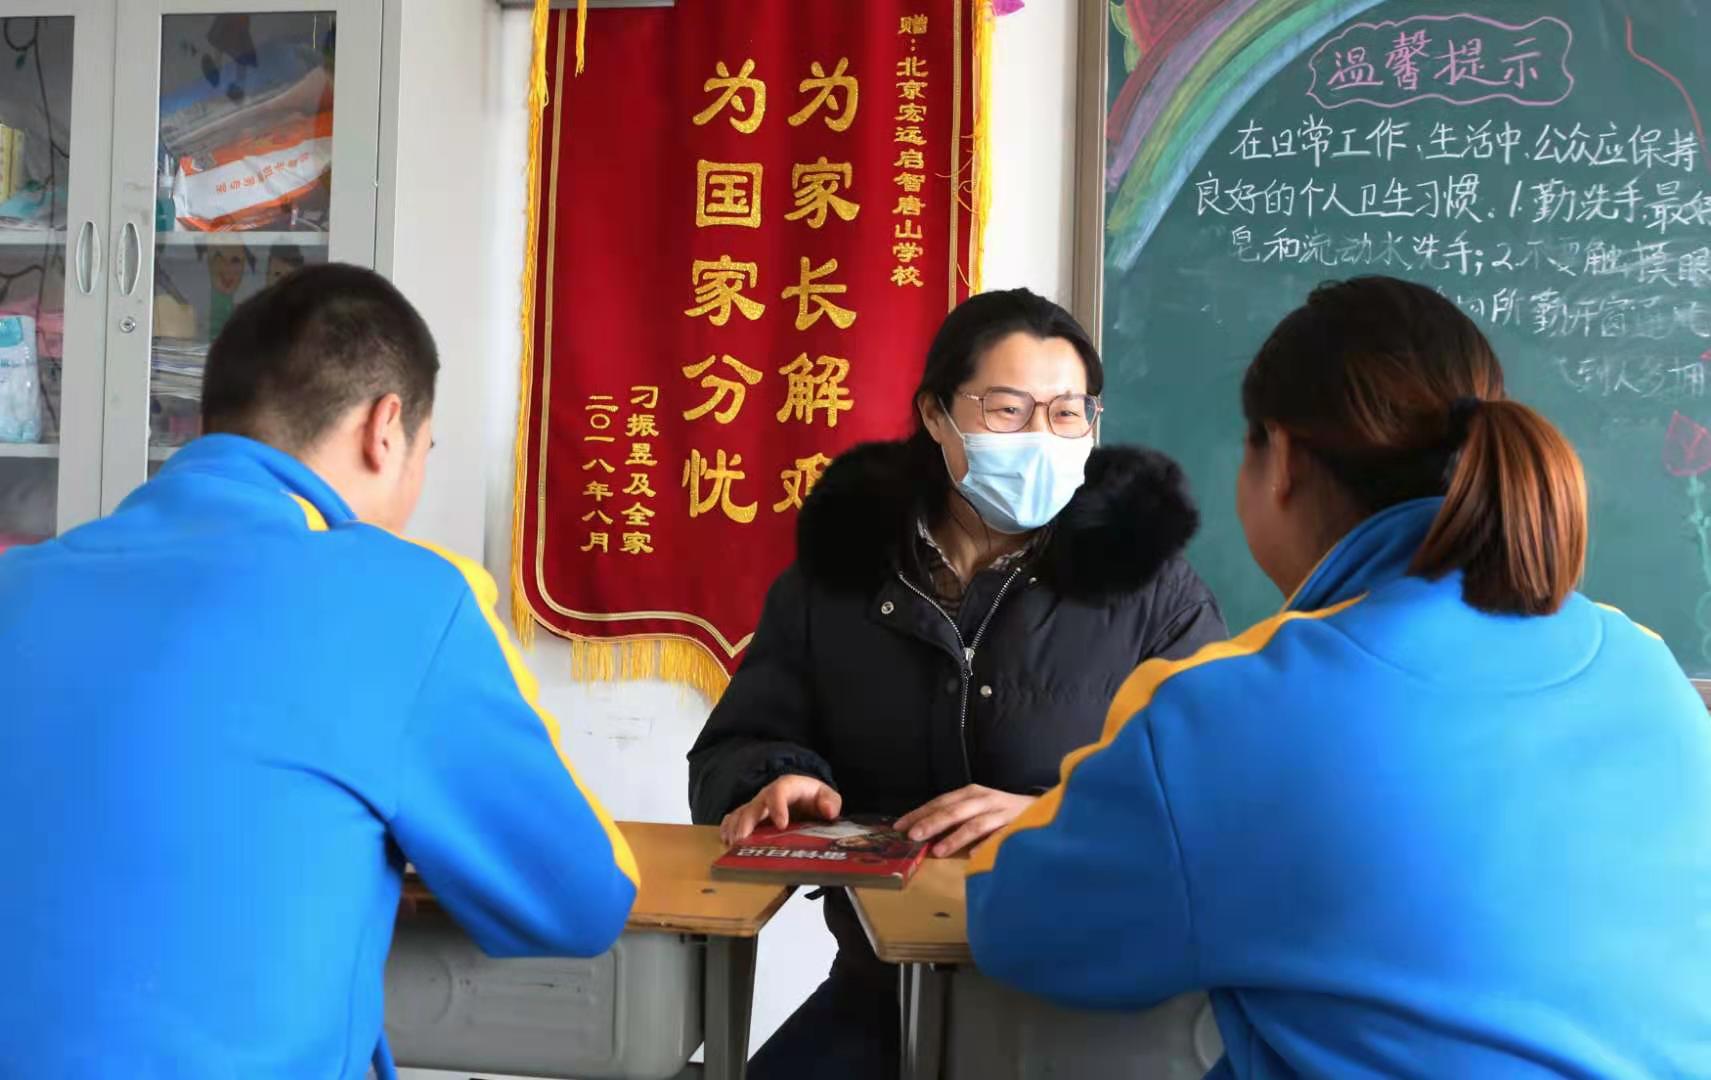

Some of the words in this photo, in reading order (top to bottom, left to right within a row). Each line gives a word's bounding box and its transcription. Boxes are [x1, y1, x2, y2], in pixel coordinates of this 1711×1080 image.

[1327, 29, 1542, 90] 温馨提示
[682, 57, 767, 523] 为国家分忧
[580, 395, 619, 553] 二〇一八年八月
[620, 385, 660, 555] 刁振昱及全家
